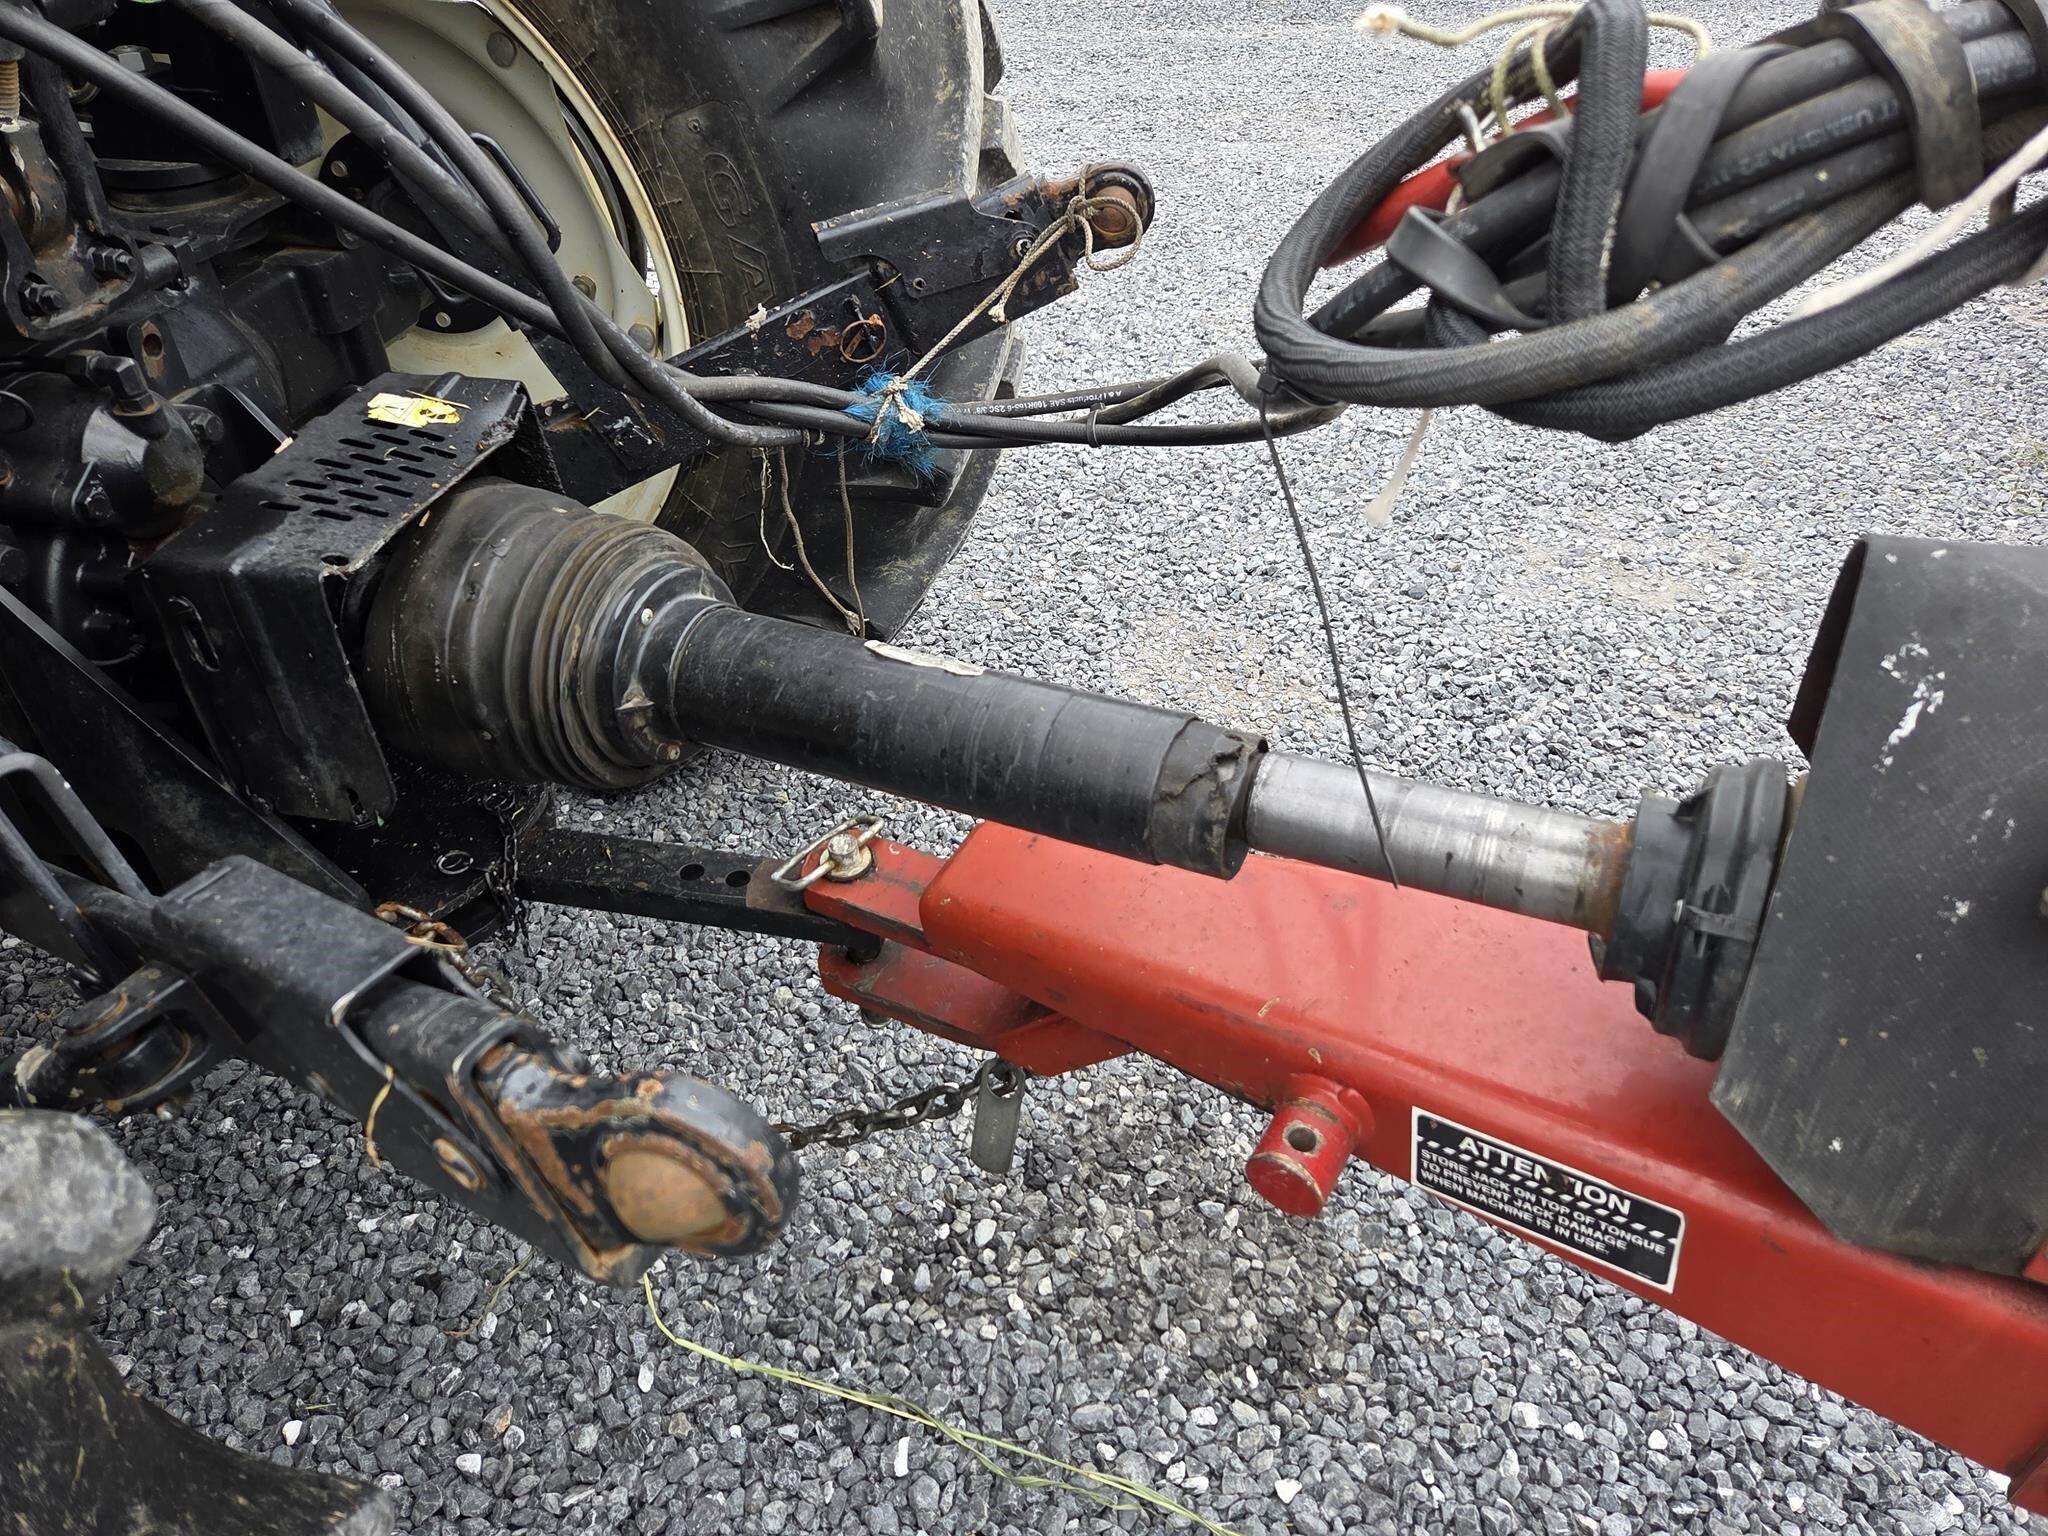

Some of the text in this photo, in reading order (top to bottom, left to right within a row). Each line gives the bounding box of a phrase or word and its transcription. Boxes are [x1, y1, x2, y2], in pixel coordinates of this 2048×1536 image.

[989, 405, 1006, 413] 2SC
[1050, 398, 1066, 407] SAE
[1421, 1149, 1666, 1255] STORE JACK ON TOP OF TONGUE
[1421, 1168, 1463, 1194] WHEN
[1466, 1188, 1534, 1222] MACHINE
[1536, 1217, 1552, 1230] IS
[1554, 1224, 1570, 1239] IN
[1421, 1159, 1627, 1251] TO PREVENT JACK DAMAGE
[1458, 1136, 1631, 1215] ATTENION
